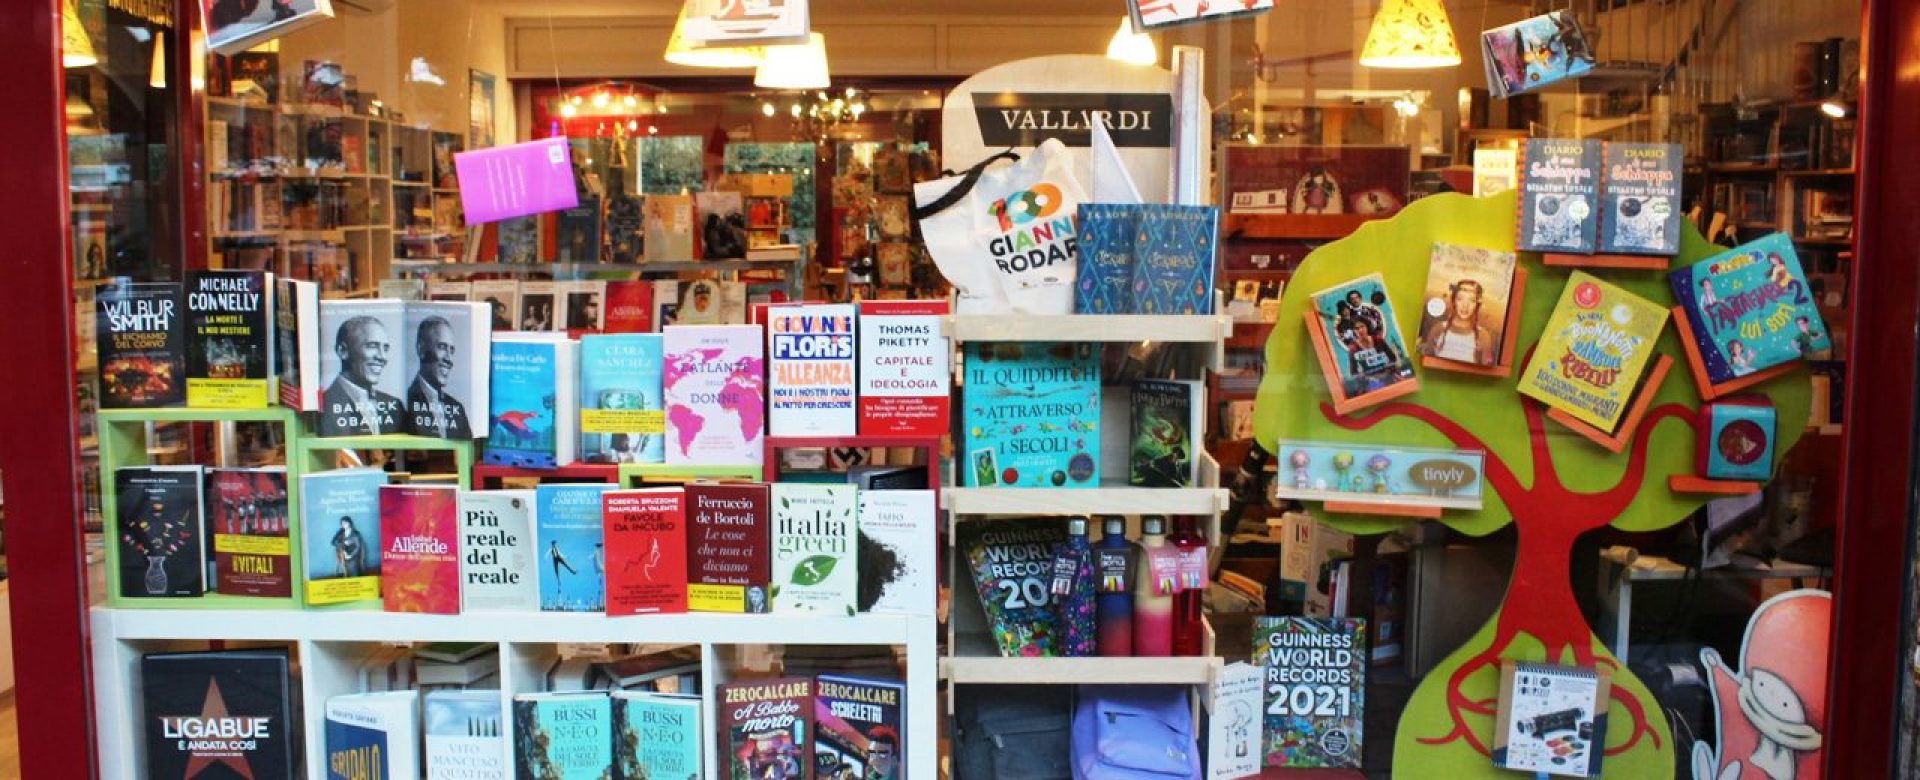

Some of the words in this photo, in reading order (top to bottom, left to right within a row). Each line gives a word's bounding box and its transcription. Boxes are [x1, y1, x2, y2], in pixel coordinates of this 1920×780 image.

[1544, 146, 1583, 155] DIARIO
[1624, 150, 1665, 158] DIARIO
[200, 278, 250, 292] MICHAEL
[103, 300, 175, 317] WILBUR
[188, 293, 259, 312] CONNELLY
[111, 315, 169, 331] SMITH
[879, 325, 930, 334] THOMAS
[879, 338, 929, 346] PIKETTY
[875, 357, 933, 366] CAPITALE
[901, 368, 907, 377] E
[973, 369, 989, 385] IL
[994, 367, 1096, 387] QUIDDITCH
[871, 380, 938, 389] IDEOLOGIA
[691, 393, 739, 404] DONNE
[333, 401, 397, 414] BARACK
[413, 401, 460, 416] BARACK
[987, 402, 1083, 419] ATTRAVERSO
[337, 414, 393, 427] OBAMA
[416, 415, 457, 429] OBAMA
[1000, 441, 1005, 454] I
[1010, 437, 1068, 454] SECOLI
[1423, 467, 1465, 484] tinyly
[698, 495, 753, 510] Ferruccio
[466, 510, 499, 527] Più
[624, 513, 664, 522] FAVOLE
[697, 512, 710, 524] de
[715, 511, 754, 526] Bortoli
[778, 510, 847, 537] italia
[632, 522, 675, 531] INCUBO
[466, 531, 516, 546] reale
[705, 528, 718, 541] Le
[721, 531, 746, 541] cose
[391, 536, 448, 554] Allende
[698, 544, 716, 556] che
[720, 547, 741, 556] non
[743, 546, 753, 557] ci
[778, 536, 847, 561] green
[467, 549, 498, 564] del
[238, 556, 273, 574] VITALI
[703, 560, 748, 573] diciamo
[468, 568, 520, 584] reale
[1269, 632, 1352, 647] GUINNESS
[1269, 648, 1351, 666] WORLD
[1268, 668, 1351, 683] RECORDS
[725, 682, 809, 703] ZEROCALCARE
[819, 682, 896, 706] ZEROCALCARE
[1267, 684, 1350, 716] 2021
[554, 708, 597, 721] BUSSI
[757, 700, 799, 717] Babbo
[830, 702, 883, 724] SCHELETRI
[643, 711, 682, 726] BUSSI
[743, 715, 794, 732] morto
[163, 718, 270, 738] LIGABUE
[188, 741, 227, 750] ANDATA
